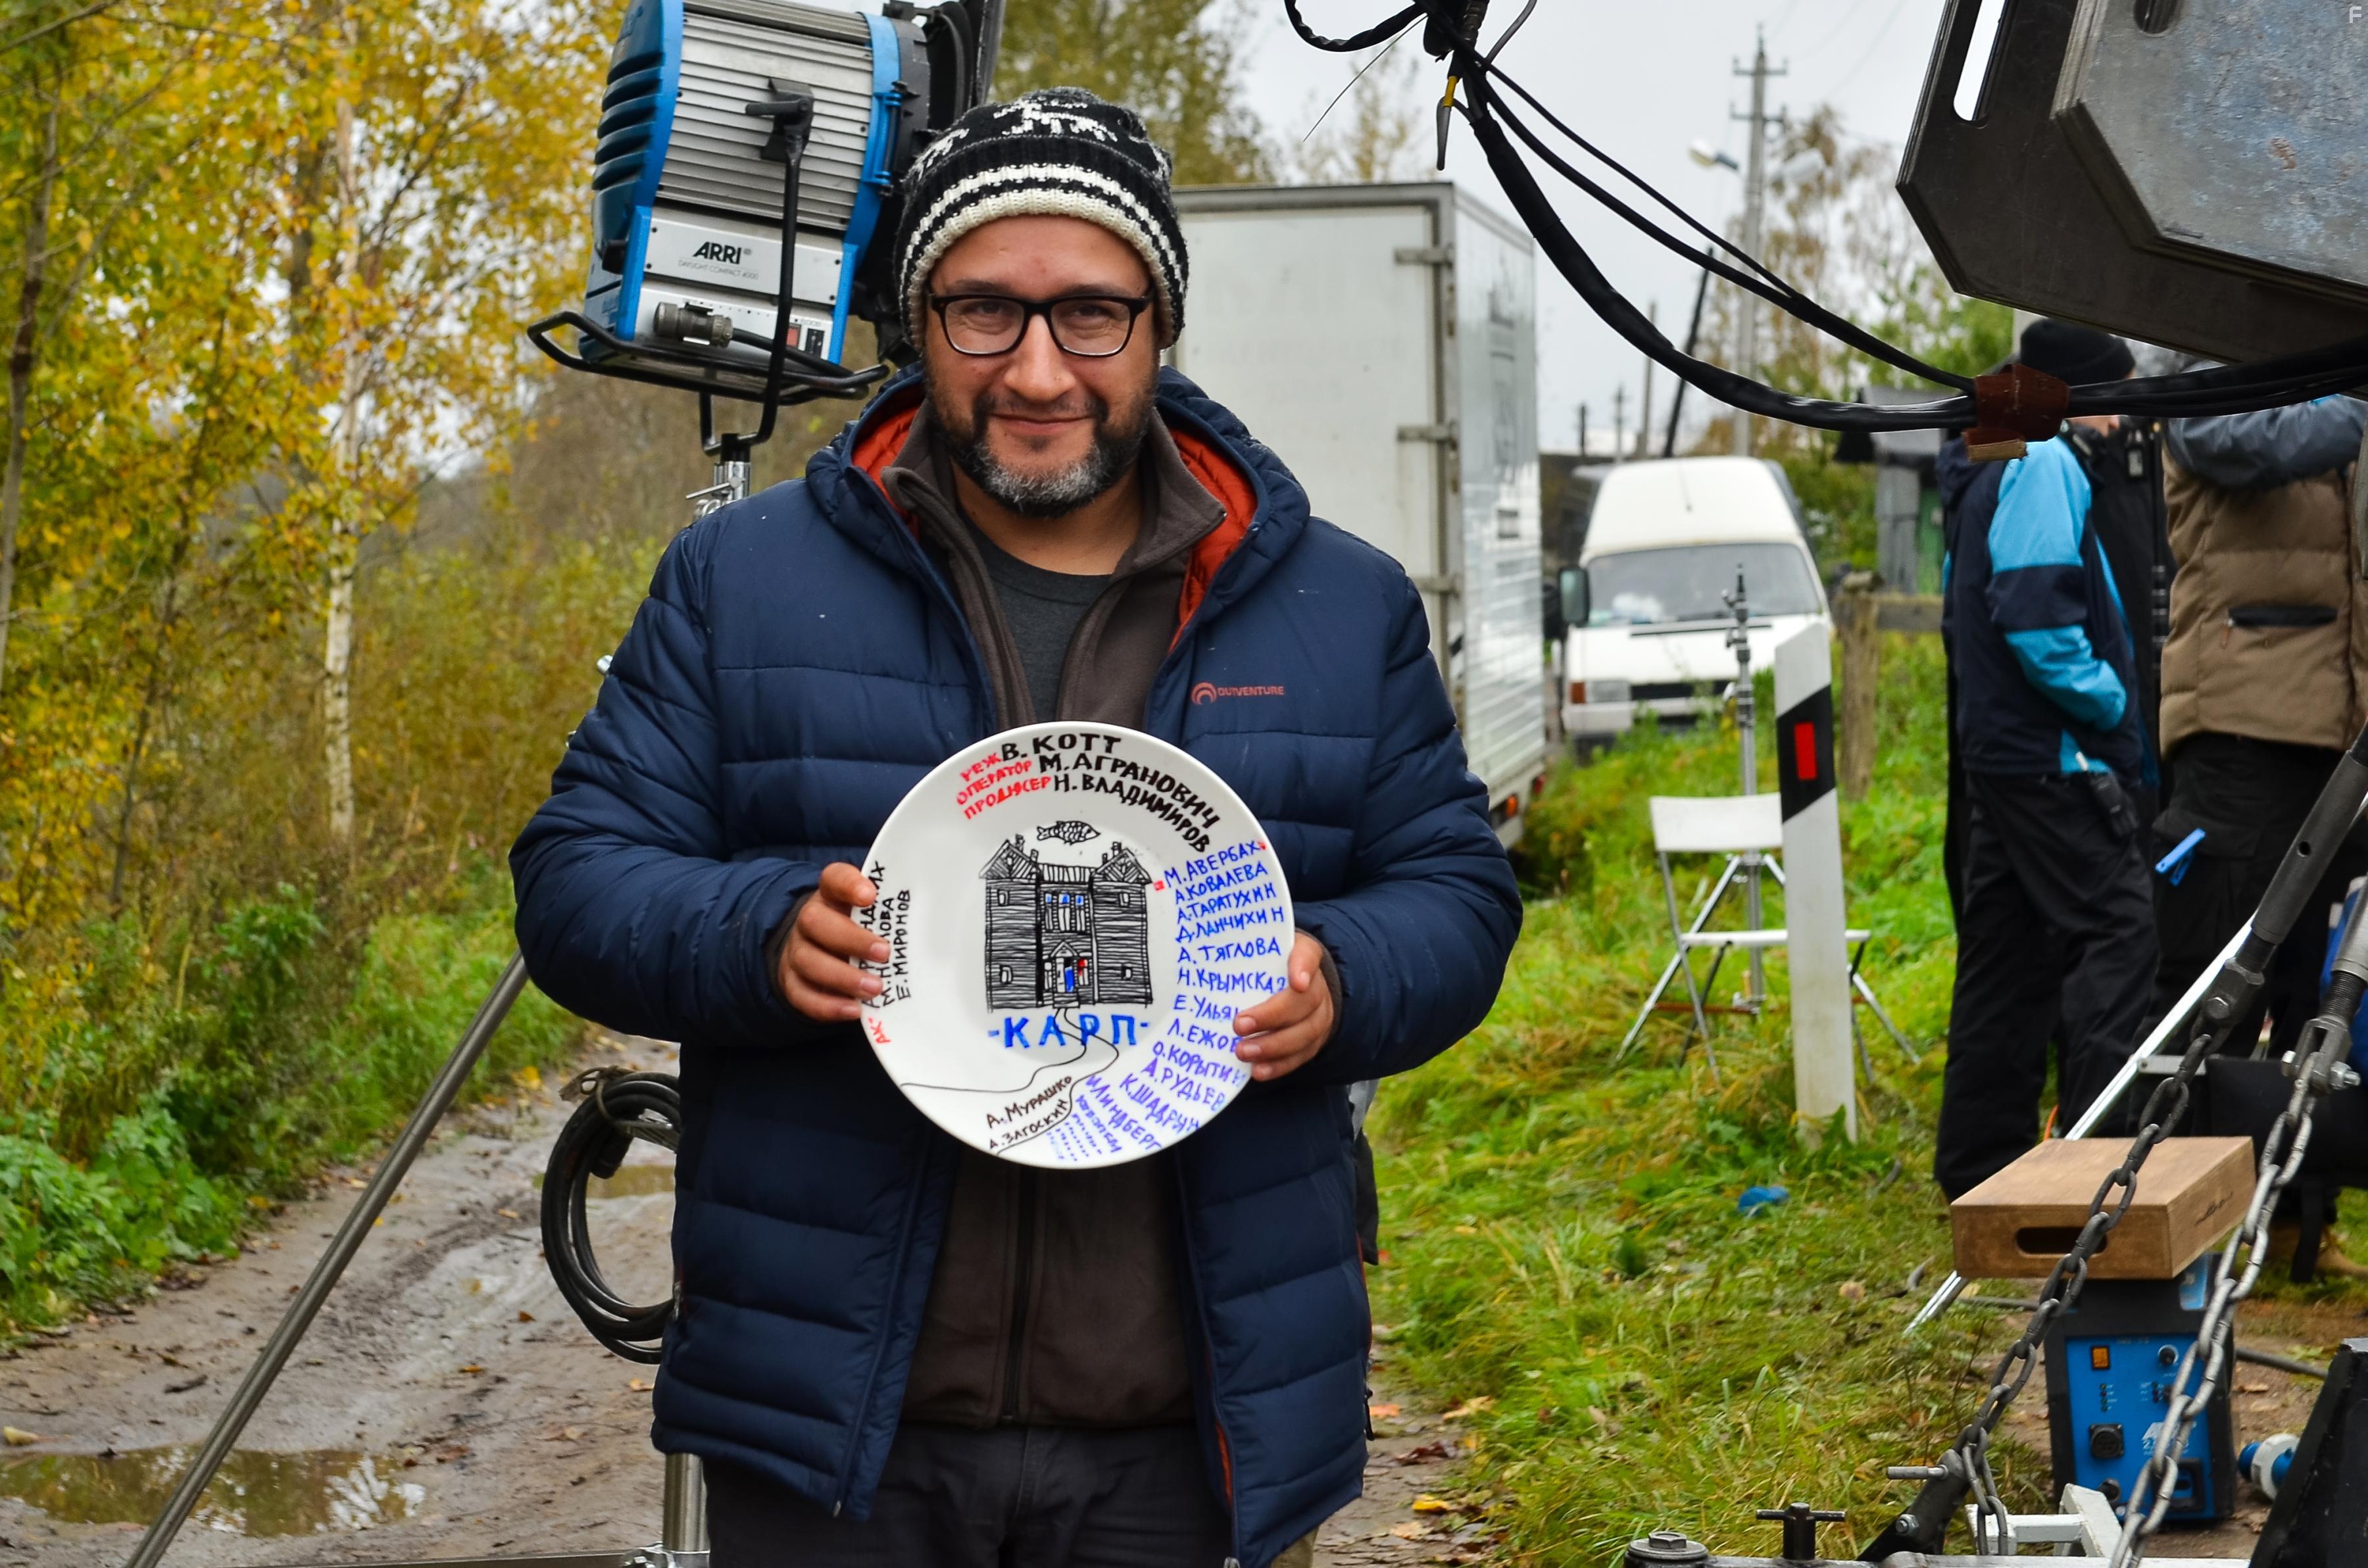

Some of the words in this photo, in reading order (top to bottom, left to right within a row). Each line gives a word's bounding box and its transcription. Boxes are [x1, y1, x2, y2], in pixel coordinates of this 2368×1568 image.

[693, 241, 741, 264] ARRI
[1218, 686, 1284, 696] OUTVENTURE
[956, 760, 1032, 804] ОПЕРАТОР
